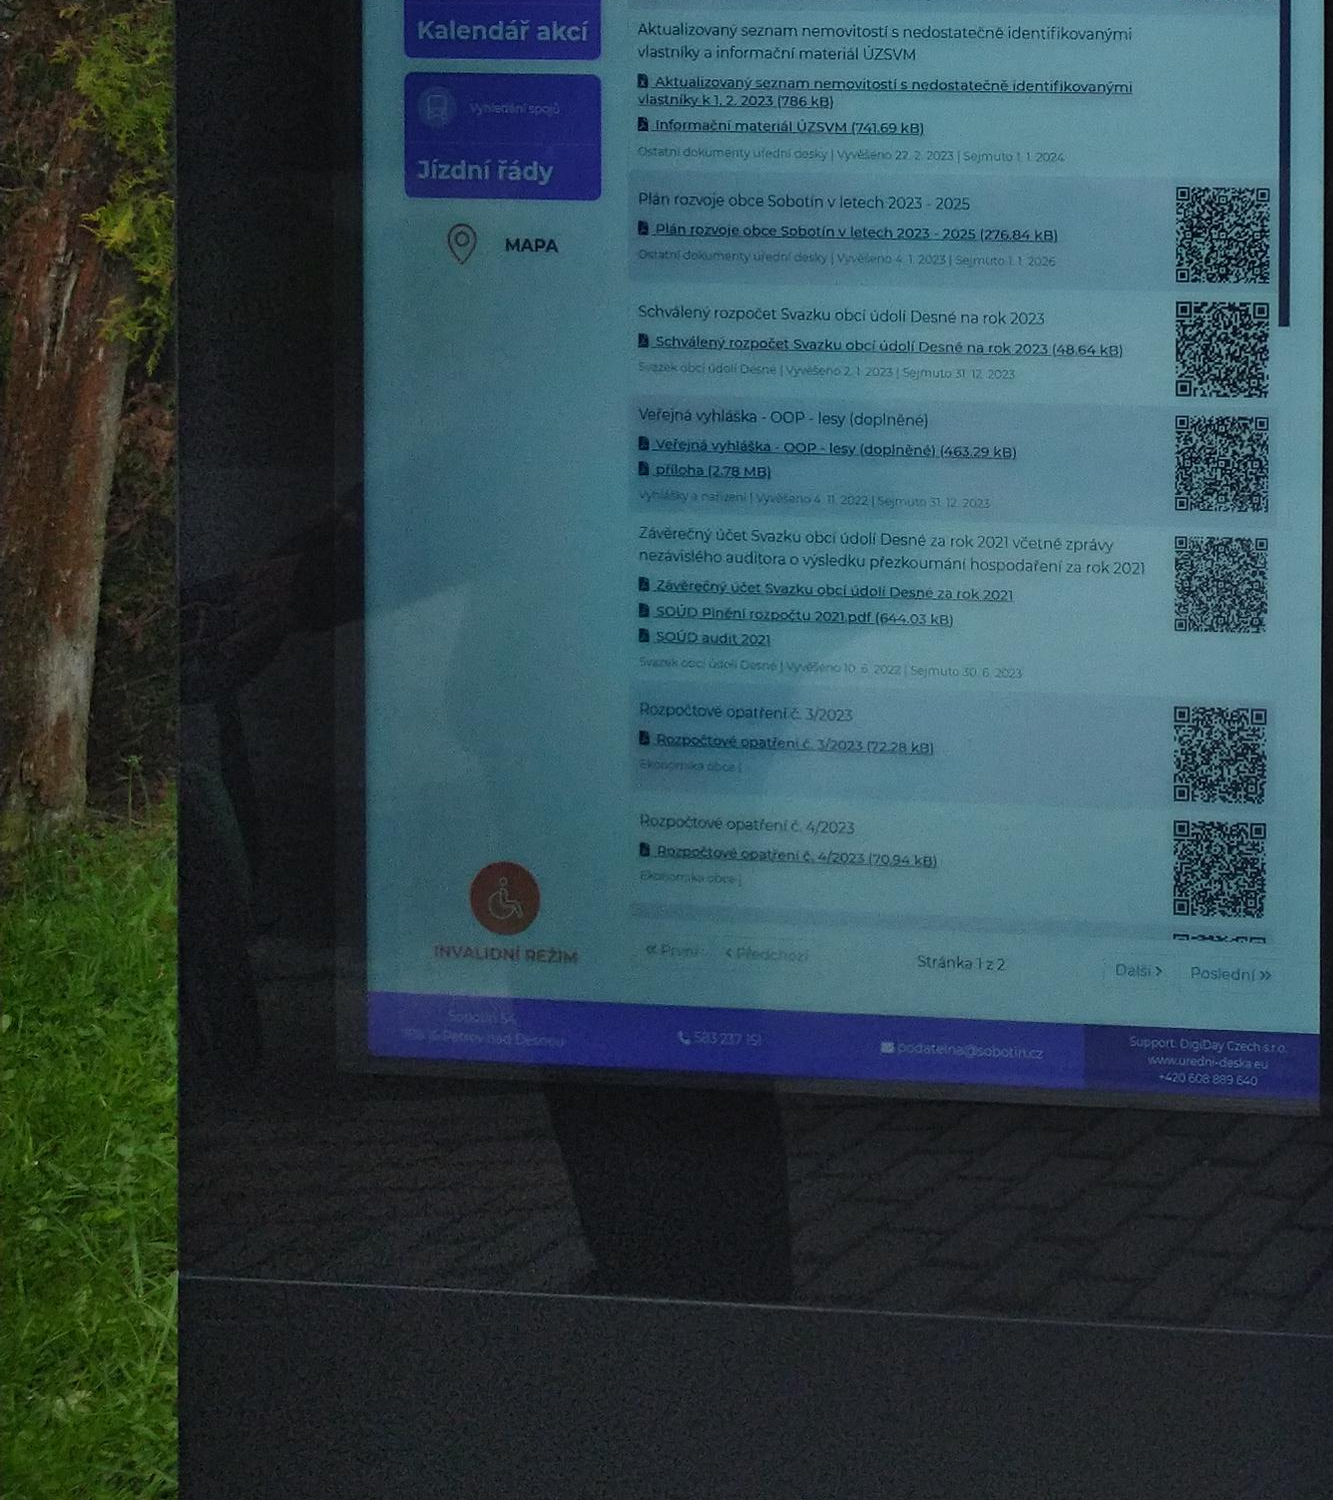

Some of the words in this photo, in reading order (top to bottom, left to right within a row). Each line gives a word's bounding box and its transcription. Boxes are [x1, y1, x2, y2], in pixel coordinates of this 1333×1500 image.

[417, 19, 530, 41] Kalendář
[536, 19, 588, 41] akcí
[636, 21, 738, 38] Aktualizovaný
[740, 26, 798, 36] seznam
[801, 23, 888, 37] nemovitostí
[891, 27, 899, 37] s
[902, 24, 1004, 38] nedostatečně
[1007, 25, 1133, 42] identifikovanými
[636, 43, 700, 60] vlastníky
[703, 48, 712, 58] a
[715, 44, 795, 59] informační
[798, 45, 859, 60] materiál
[862, 44, 917, 60] ÚZSVM
[417, 158, 492, 180] Jízdní
[498, 159, 554, 186] řády
[637, 192, 670, 206] Plán
[673, 193, 725, 209] rozvoje
[727, 193, 764, 207] obce
[767, 194, 824, 208] Sobotín
[826, 198, 836, 208] v
[839, 195, 884, 208] letech
[887, 195, 923, 209] 2023
[935, 196, 971, 209] 2025
[505, 237, 559, 253] MAPA
[637, 305, 711, 322] Schválený
[713, 306, 777, 323] rozpočet
[780, 307, 831, 321] Svazku
[834, 308, 866, 322] obcí
[869, 309, 906, 322] údolí
[910, 309, 957, 323] Desné
[960, 313, 979, 323] na
[982, 310, 1007, 324] rok
[1009, 311, 1045, 324] 2023
[637, 407, 692, 424] Veřejná
[695, 408, 757, 425] vyhláška
[769, 409, 805, 423] OOP
[817, 410, 846, 427] lesy
[849, 411, 928, 428] (doplněné)
[639, 702, 723, 720] Rozpočtové
[725, 705, 788, 722] opatření
[805, 707, 854, 724] 3/2023
[639, 814, 723, 832] Rozpočtové
[725, 817, 788, 834] opatření
[805, 819, 855, 836] 4/2023
[433, 942, 520, 962] INVALIDNÍ
[525, 943, 579, 965] REŽIM
[917, 954, 973, 971] Stránka
[985, 960, 995, 971] z
[996, 958, 1006, 972] 2
[1115, 961, 1152, 978] Další
[1190, 965, 1256, 982] Poslední
[1179, 1038, 1224, 1054] DigiDay
[1225, 1039, 1261, 1053] Czech
